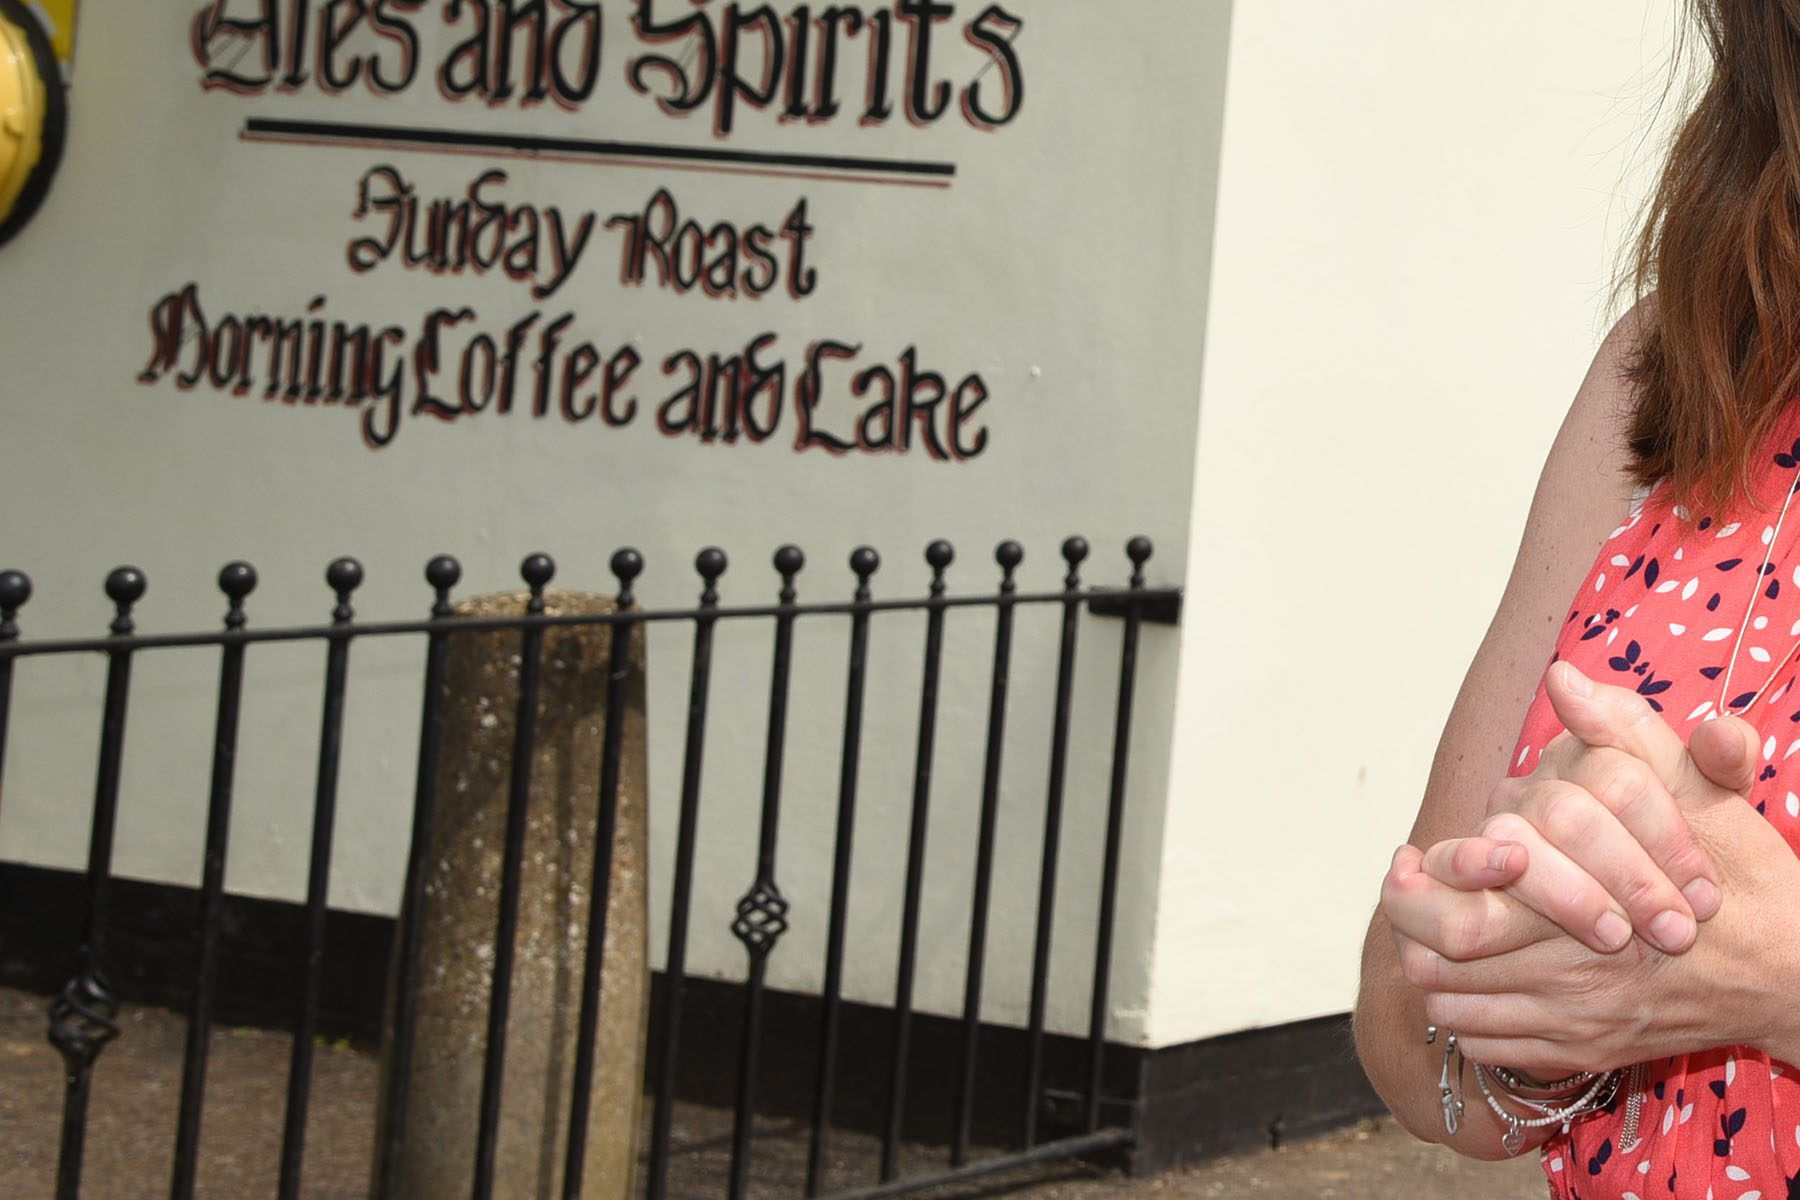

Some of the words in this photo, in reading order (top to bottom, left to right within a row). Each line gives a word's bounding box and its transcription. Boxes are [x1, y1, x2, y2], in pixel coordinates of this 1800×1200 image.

[348, 165, 596, 301] Sunday
[605, 187, 817, 301] Roast
[138, 283, 407, 450] Morning
[413, 307, 641, 428] Coffee
[657, 332, 788, 445] and
[794, 338, 990, 462] Cake
